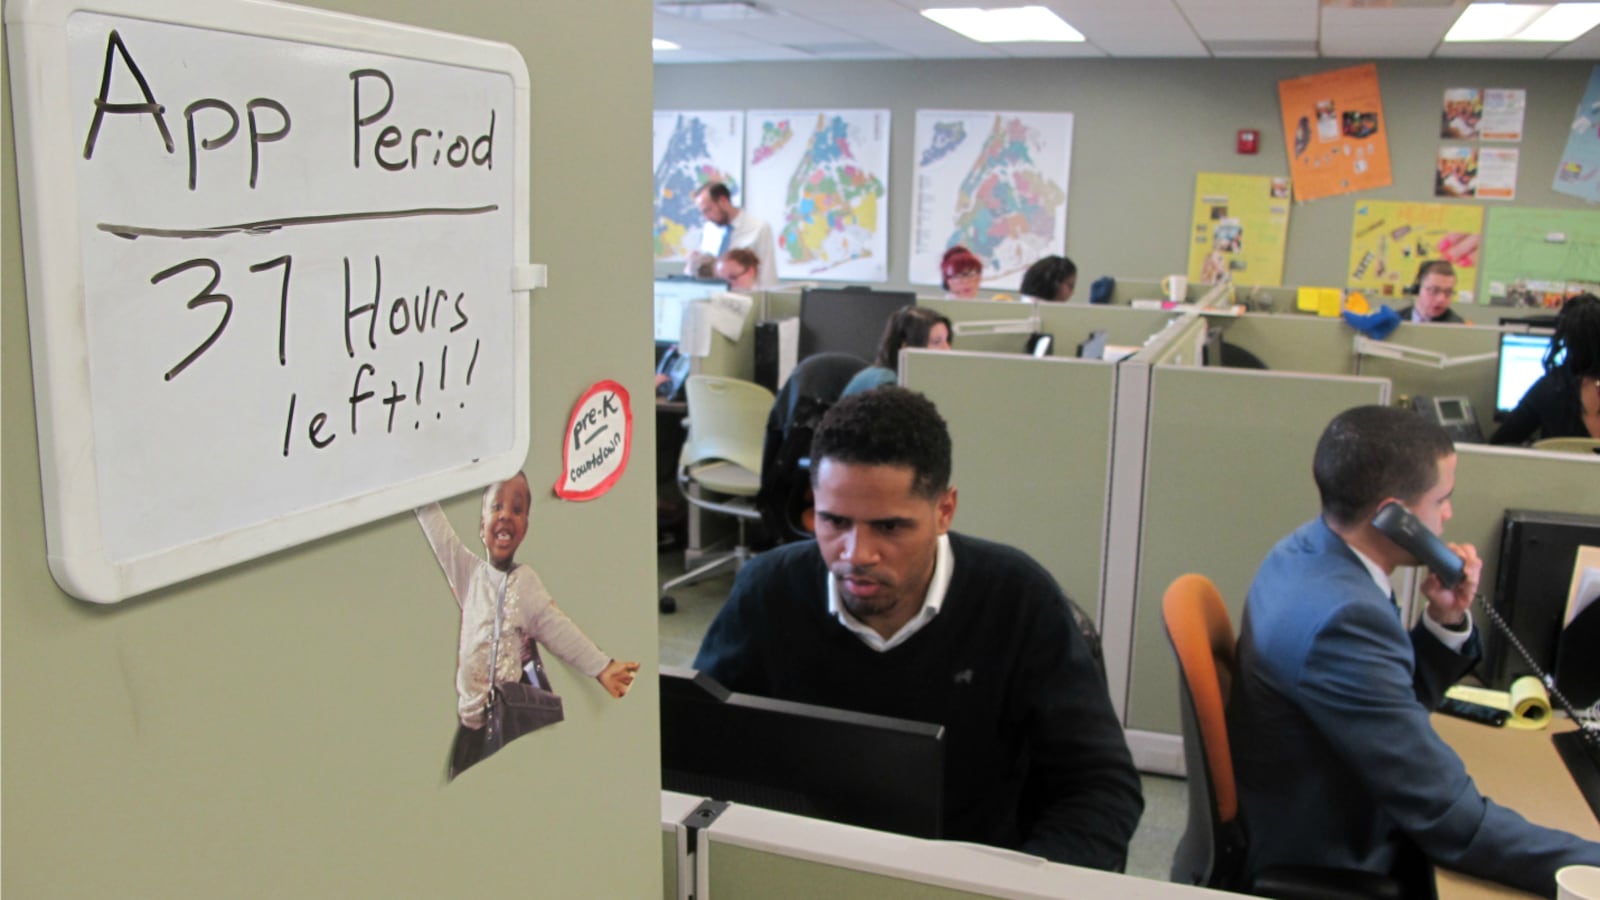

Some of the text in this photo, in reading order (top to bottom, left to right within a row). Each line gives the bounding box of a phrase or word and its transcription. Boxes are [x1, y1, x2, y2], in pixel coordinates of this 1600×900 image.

[83, 29, 496, 190] App Period
[150, 254, 469, 382] 37 Hours
[282, 338, 480, 457] left!!!
[570, 432, 621, 482] countdown
